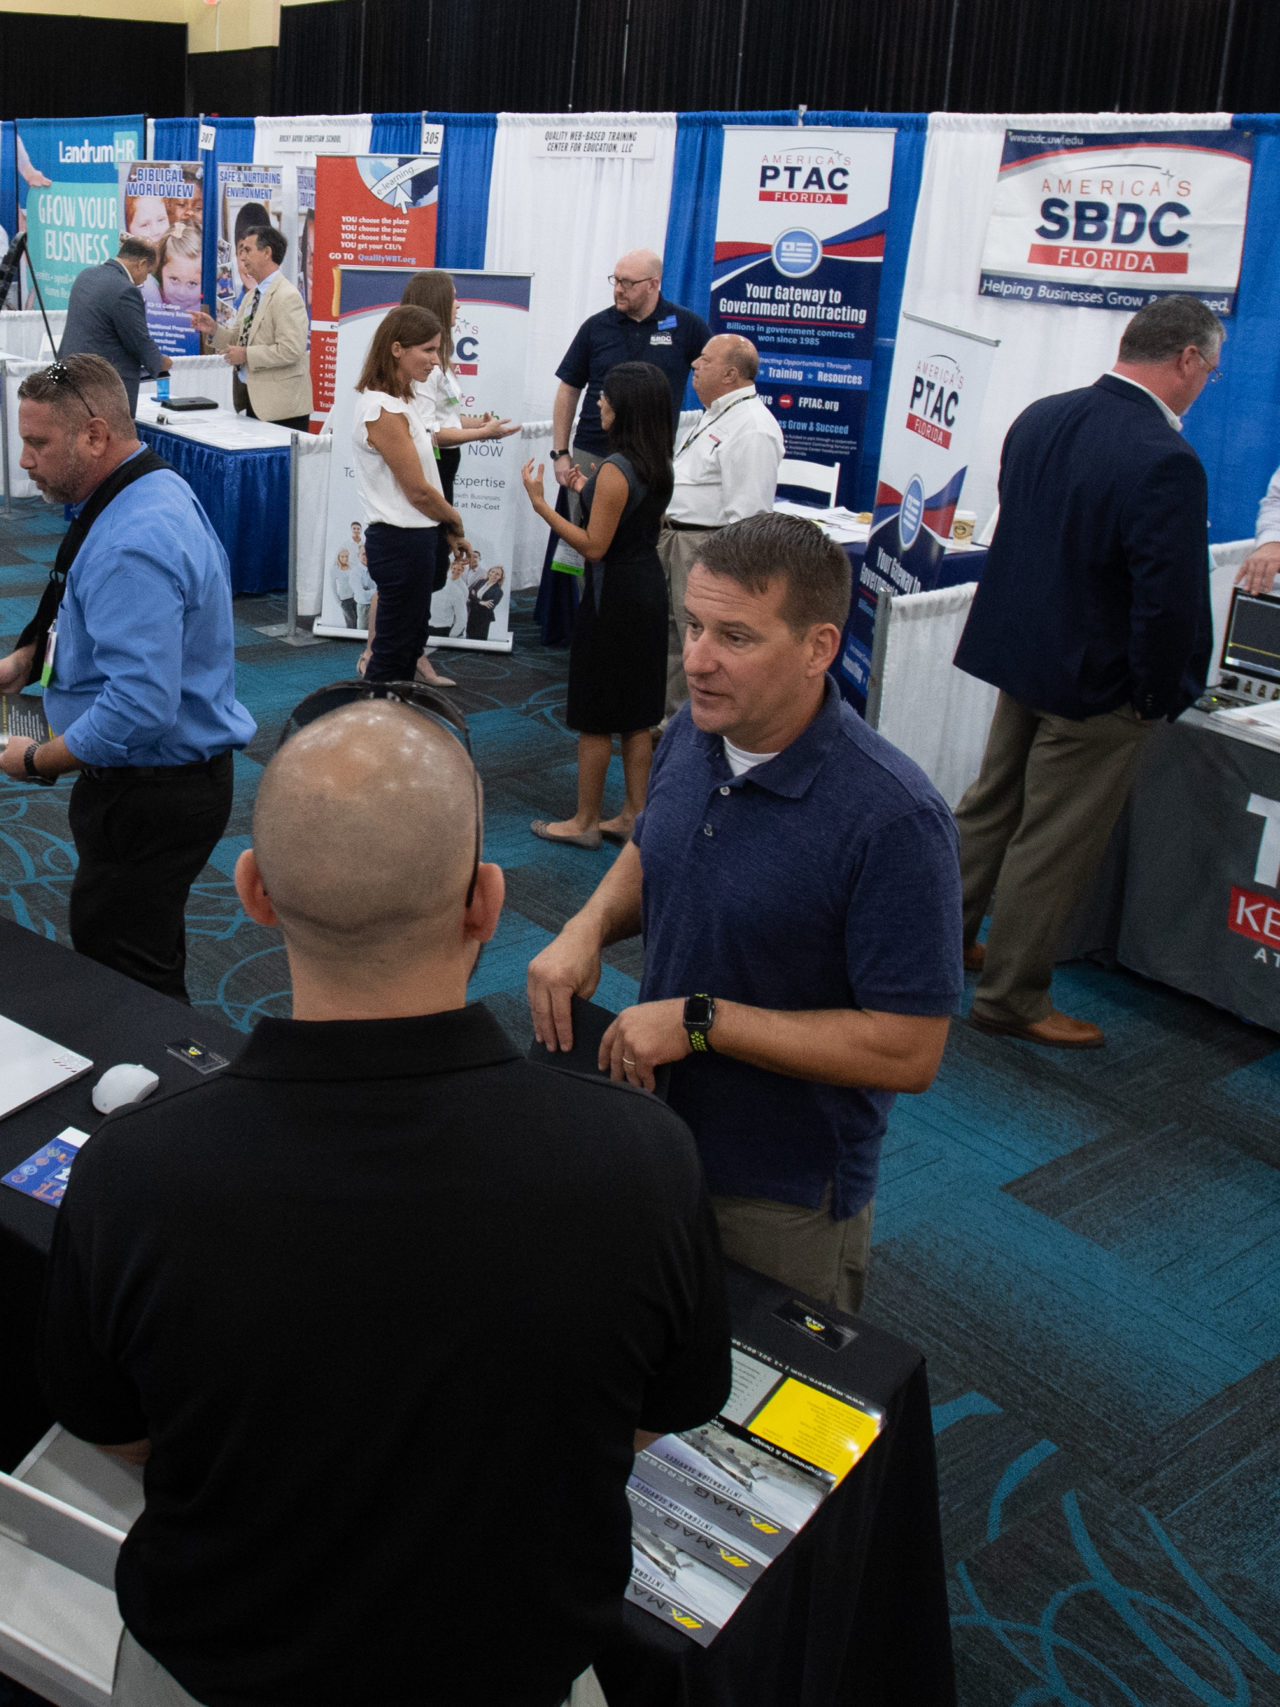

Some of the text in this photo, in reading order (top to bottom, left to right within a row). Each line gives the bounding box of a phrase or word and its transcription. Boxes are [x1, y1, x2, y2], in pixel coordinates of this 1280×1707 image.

[304, 134, 325, 143] CHRISTIAN
[326, 134, 342, 143] SCHOOL
[424, 132, 440, 145] 305
[545, 131, 637, 142] QUALITY WEB-BASED TRAINING
[547, 142, 569, 152] CENTER
[570, 142, 582, 152] FOR
[621, 143, 634, 153] LLC
[137, 168, 184, 183] BIBLICAL
[220, 170, 235, 182] SAFE
[243, 172, 281, 184] NURTURING
[759, 165, 850, 191] PTAC
[127, 182, 195, 198] WORLDVIEW
[226, 186, 273, 200] ENVIRONMENT
[774, 191, 833, 204] FLORIDA
[77, 197, 118, 230] YOUR
[341, 215, 358, 223] YOU
[393, 218, 410, 226] place
[341, 224, 357, 232] YOU
[1035, 198, 1191, 247] SBDC
[341, 232, 357, 240] YOU
[45, 229, 110, 265] BUSINESS
[357, 243, 368, 251] get
[368, 243, 383, 251] your
[329, 252, 342, 260] GO
[343, 252, 354, 260] TO
[1058, 248, 1156, 272] FLORIDA
[746, 283, 842, 305] Your Gateway to
[983, 279, 1144, 307] Helping Businesses Grow
[719, 298, 867, 324] Government Contracting
[726, 322, 855, 339] Billions in government contracts
[776, 335, 798, 345] since
[799, 336, 820, 346] 1985
[783, 359, 852, 370] Opportunities Through
[768, 367, 863, 385] Training Resources
[798, 397, 840, 412] FPTAC.org
[909, 375, 960, 428] PTAC
[788, 420, 807, 431] Grow
[808, 422, 814, 431] &
[816, 422, 849, 435] Succeed
[914, 418, 944, 445] FLORIDA
[468, 444, 504, 457] NOW
[454, 475, 506, 488] Expertise
[470, 502, 500, 511] No-Cost
[1246, 792, 1280, 889] T
[1235, 896, 1280, 940] KE
[664, 1453, 742, 1500] INTEGRATION SERVICES
[634, 1482, 713, 1531] INTEGRATION SERVICES
[694, 1486, 745, 1518] MAG
[663, 1517, 714, 1550] MAG
[631, 1566, 665, 1590] INTEGRA
[633, 1585, 667, 1610] MA
